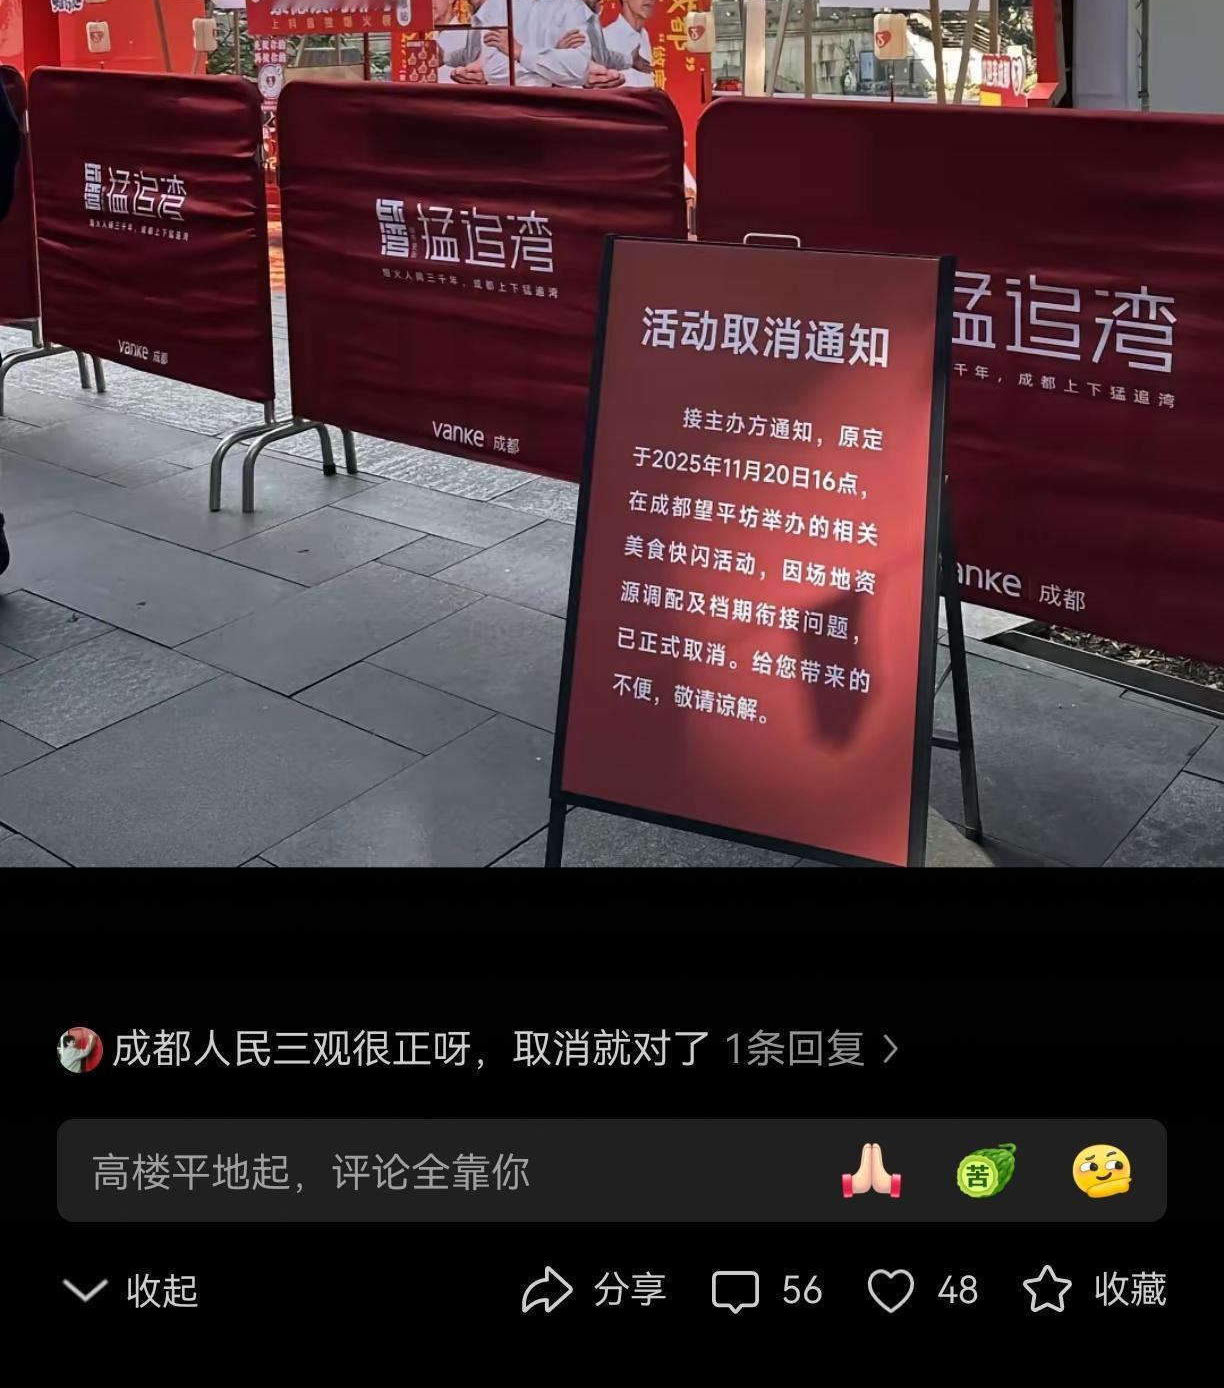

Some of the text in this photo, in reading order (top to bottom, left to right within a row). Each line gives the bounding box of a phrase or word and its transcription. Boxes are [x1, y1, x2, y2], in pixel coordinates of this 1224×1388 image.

[417, 202, 554, 273] 猛追湾
[641, 306, 889, 368] 活动取消通知
[432, 420, 520, 455] vanke 成都
[683, 407, 884, 451] 接主办方通知，原定
[633, 446, 869, 500] 于2025年11月20日16点，
[628, 490, 879, 547] 在成都望平坊举办的相关
[624, 534, 876, 596] 美食快闪活动，因场地资
[620, 579, 861, 646] 源调配及档期衔接问题，
[1038, 582, 1086, 612] 成都
[617, 626, 870, 694] 已正式取消。给您带来的
[612, 672, 768, 724] 不便，敬请谅解。
